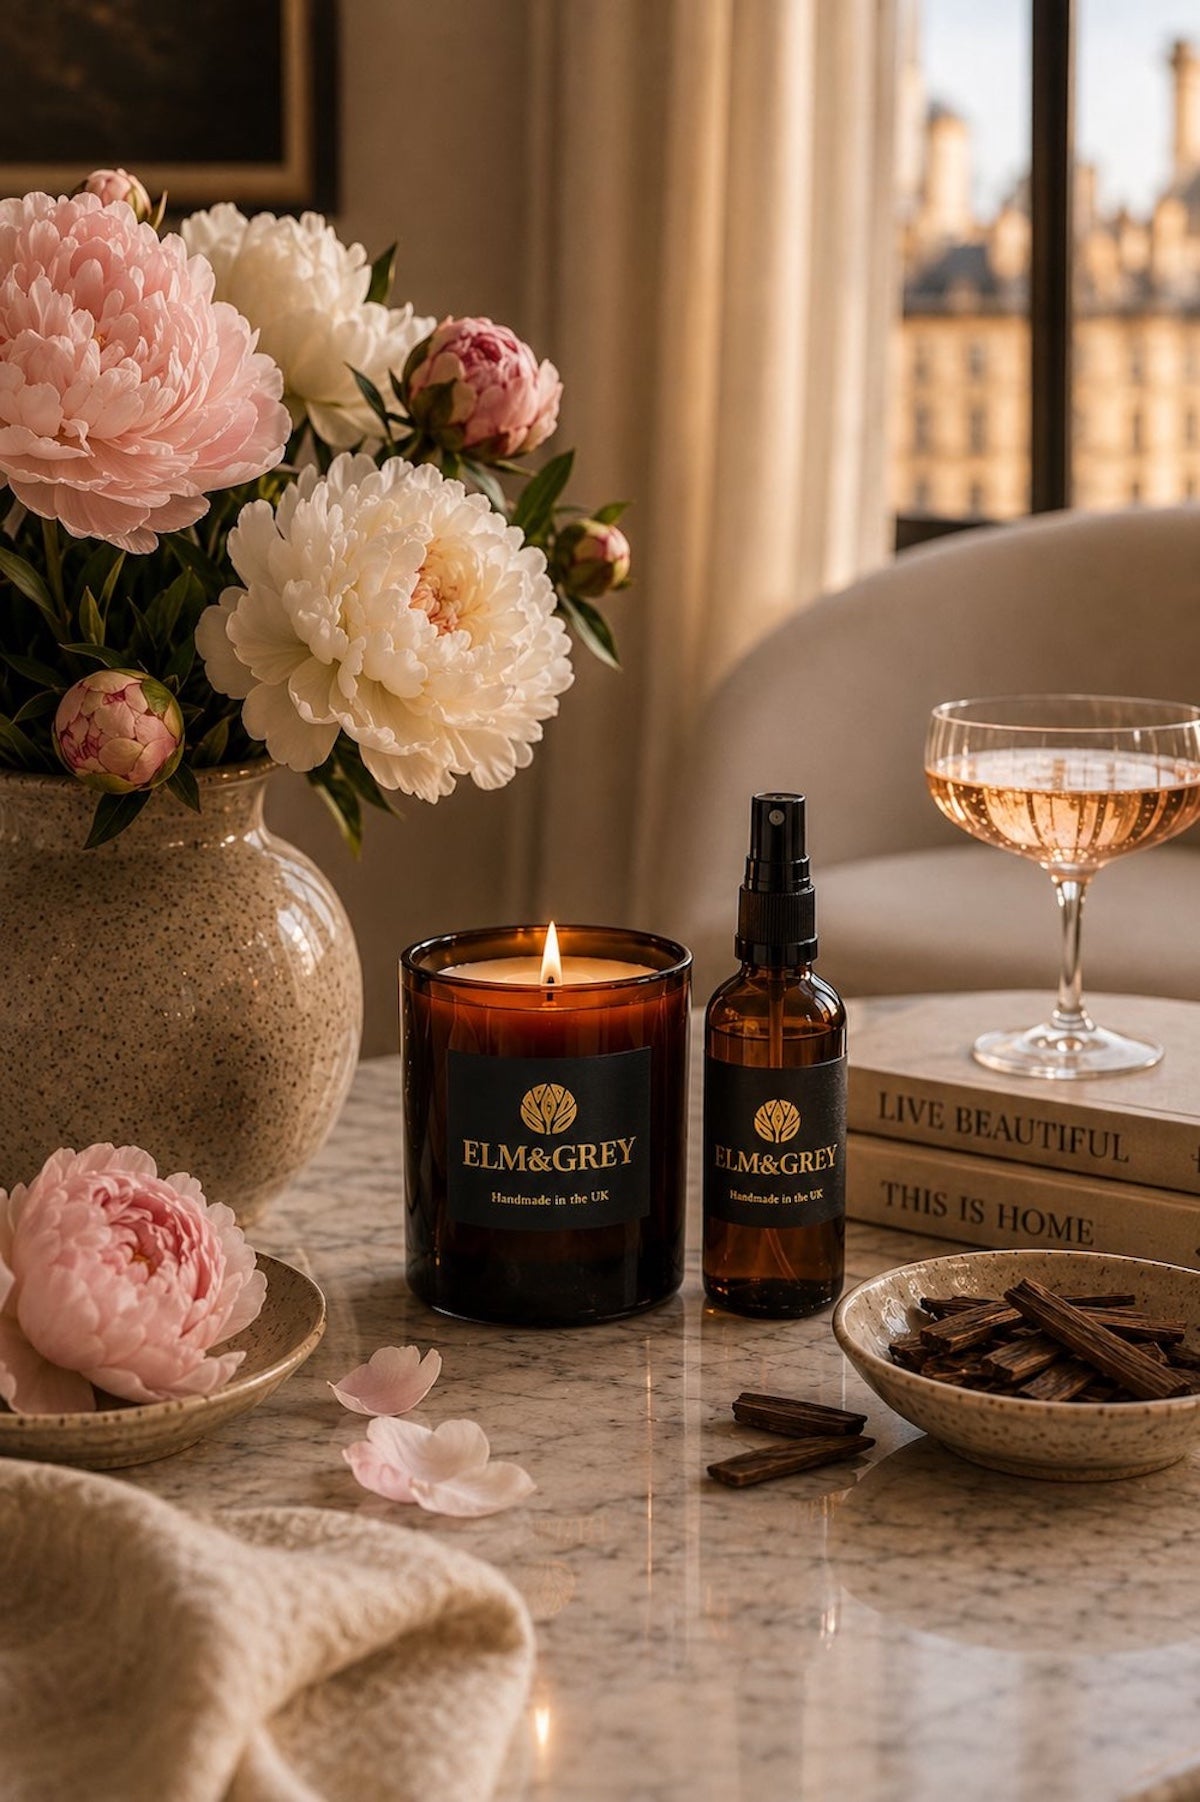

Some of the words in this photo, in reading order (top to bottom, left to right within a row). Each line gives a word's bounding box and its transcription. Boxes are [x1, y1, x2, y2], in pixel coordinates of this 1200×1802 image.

[878, 1091, 944, 1130] LIVE
[955, 1106, 1130, 1163] BEAUTIFUL
[462, 1136, 637, 1172] ELM&GREY
[714, 1144, 838, 1176] ELM&GREY
[491, 1191, 552, 1206] Handmade
[554, 1194, 566, 1205] in
[568, 1192, 588, 1205] the
[590, 1190, 610, 1202] UK
[729, 1189, 780, 1204] Handmade
[781, 1194, 792, 1204] in
[793, 1191, 808, 1203] the
[809, 1188, 824, 1200] UK
[880, 1179, 948, 1218] THIS
[959, 1195, 985, 1225] IS
[996, 1203, 1095, 1246] HOME
